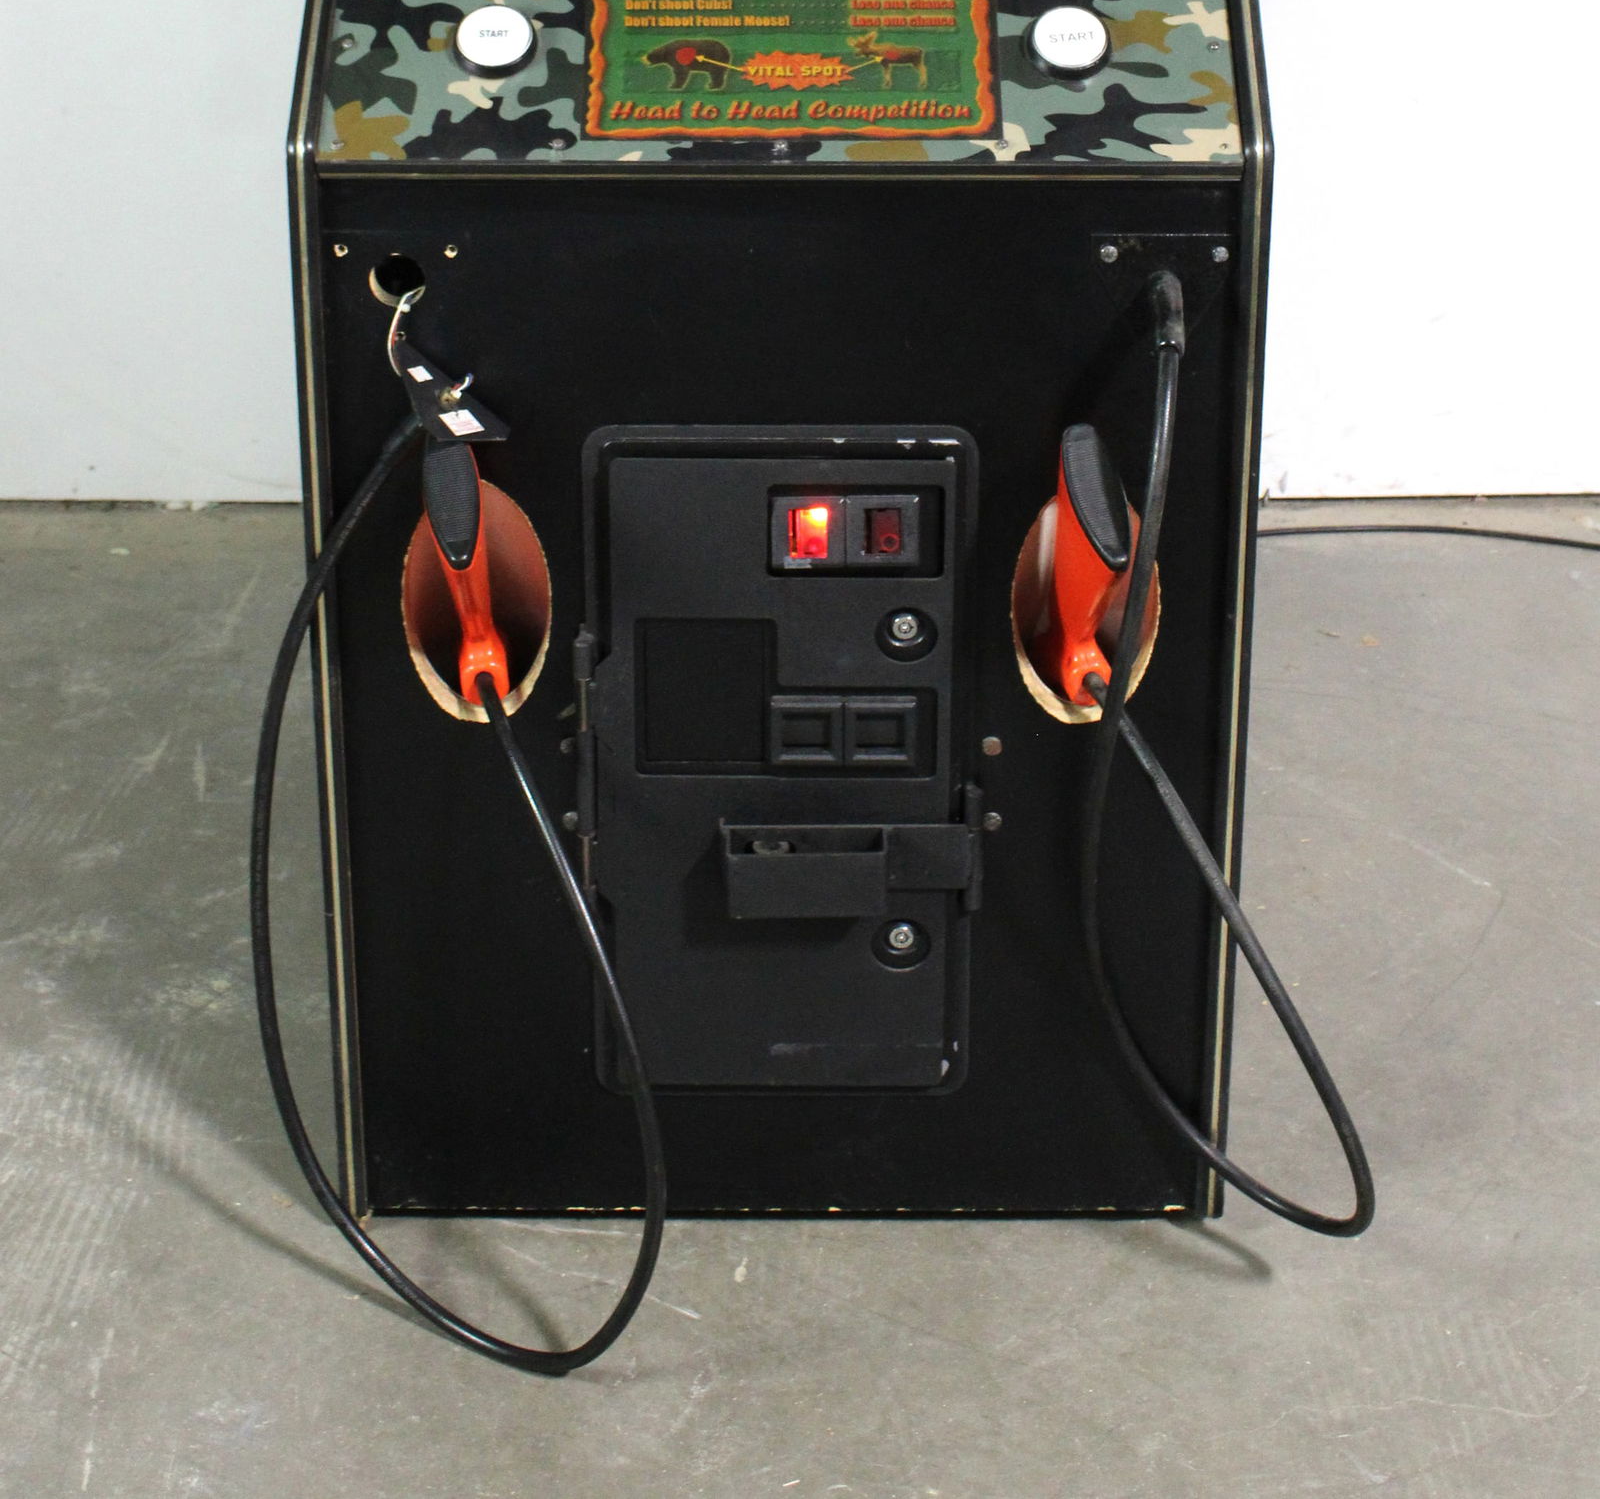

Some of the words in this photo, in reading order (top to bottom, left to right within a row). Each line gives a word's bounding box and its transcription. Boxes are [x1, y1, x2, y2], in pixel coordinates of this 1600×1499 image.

[624, 15, 656, 27] Don't
[658, 15, 693, 27] shoot
[696, 15, 741, 27] Female
[744, 15, 790, 27] Moose!
[479, 30, 509, 38] START
[1049, 31, 1094, 43] START
[749, 66, 794, 77] VITAL
[801, 66, 844, 77] SPOT
[609, 101, 682, 120] Head
[689, 101, 721, 120] to
[727, 101, 799, 120] Head
[807, 101, 973, 124] Competition
